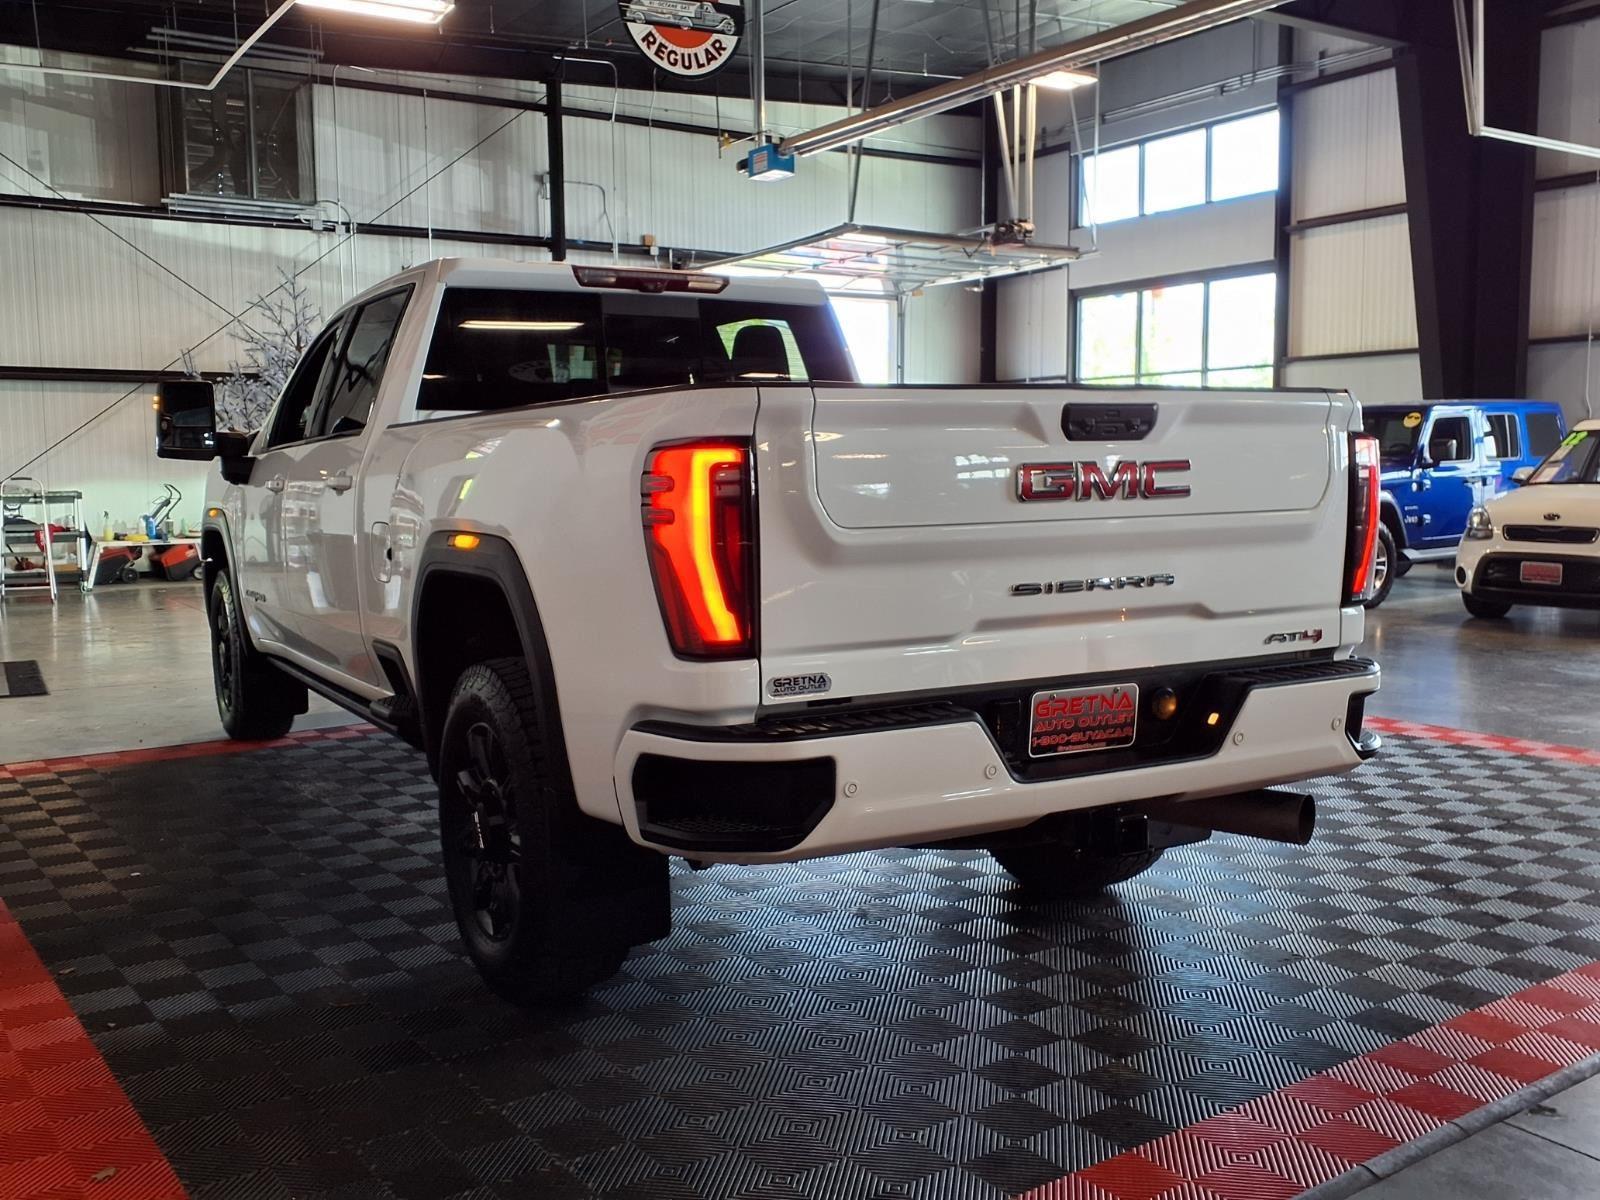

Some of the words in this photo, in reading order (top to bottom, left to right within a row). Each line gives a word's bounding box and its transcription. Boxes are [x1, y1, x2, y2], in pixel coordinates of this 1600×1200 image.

[641, 30, 728, 70] REGULAR
[1016, 459, 1191, 502] GMC
[1010, 573, 1175, 597] SIERRA
[1263, 628, 1323, 645] AT4
[773, 675, 827, 688] GRETNA
[773, 686, 796, 694] AUTO
[798, 683, 827, 691] OUTLET
[1035, 691, 1134, 718] GRETNA
[1033, 718, 1075, 733] AUTO
[1078, 713, 1134, 728] OUTLET
